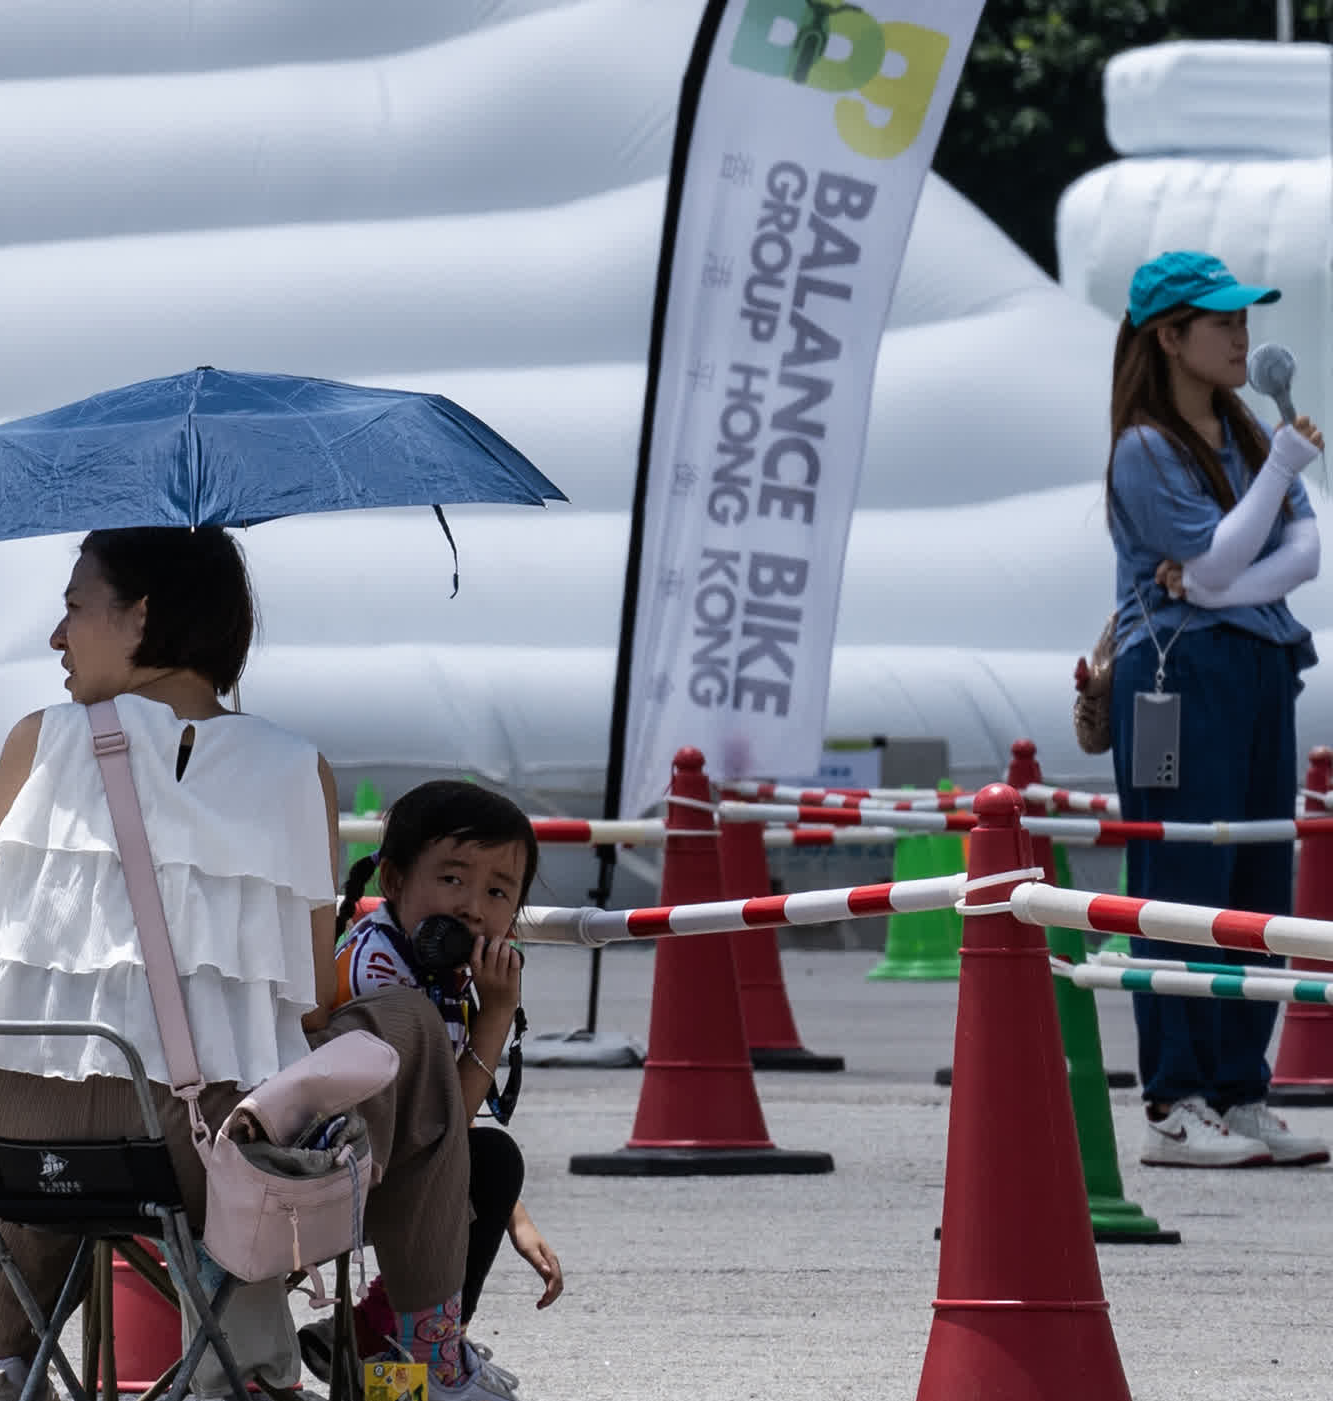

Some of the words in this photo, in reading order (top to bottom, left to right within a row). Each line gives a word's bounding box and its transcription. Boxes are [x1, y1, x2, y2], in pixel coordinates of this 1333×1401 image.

[740, 161, 809, 344] GROUP
[758, 171, 878, 526] BALANCE
[707, 364, 769, 527] HONG
[688, 549, 741, 710] KONG
[734, 551, 809, 718] BIKE
